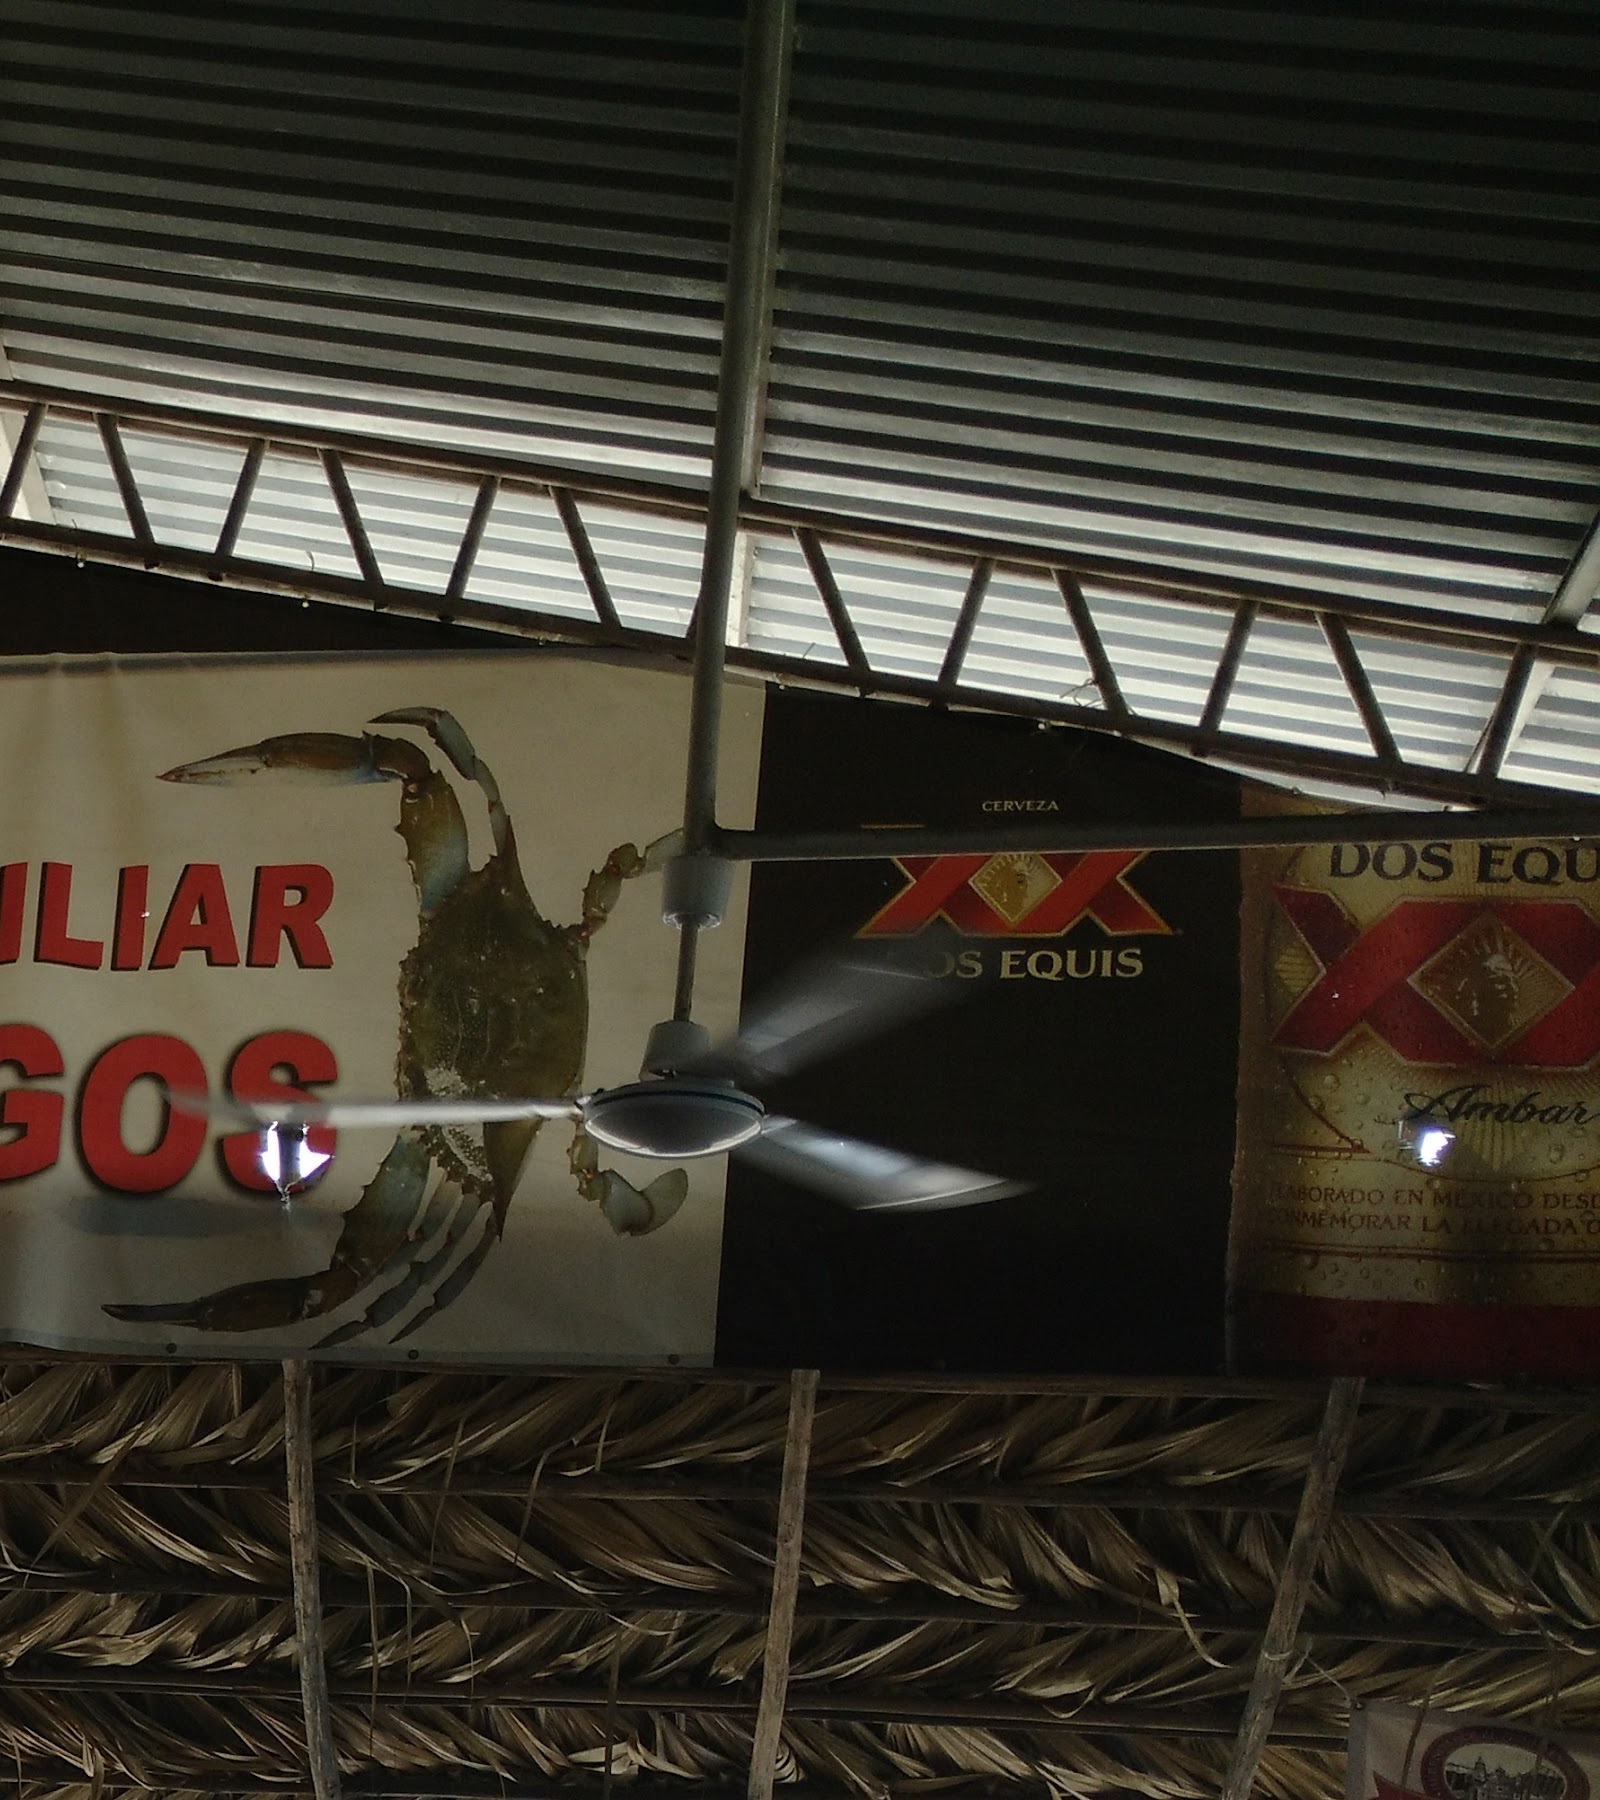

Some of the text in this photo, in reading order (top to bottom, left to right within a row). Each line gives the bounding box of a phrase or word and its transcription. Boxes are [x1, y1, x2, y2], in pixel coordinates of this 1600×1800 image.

[981, 800, 1060, 812] CERVEZA
[1329, 843, 1453, 883] DOS
[999, 949, 1144, 981] EQUIS
[1374, 1084, 1600, 1125] Ambar
[1395, 1189, 1423, 1205] EN
[1422, 1216, 1450, 1233] LA
